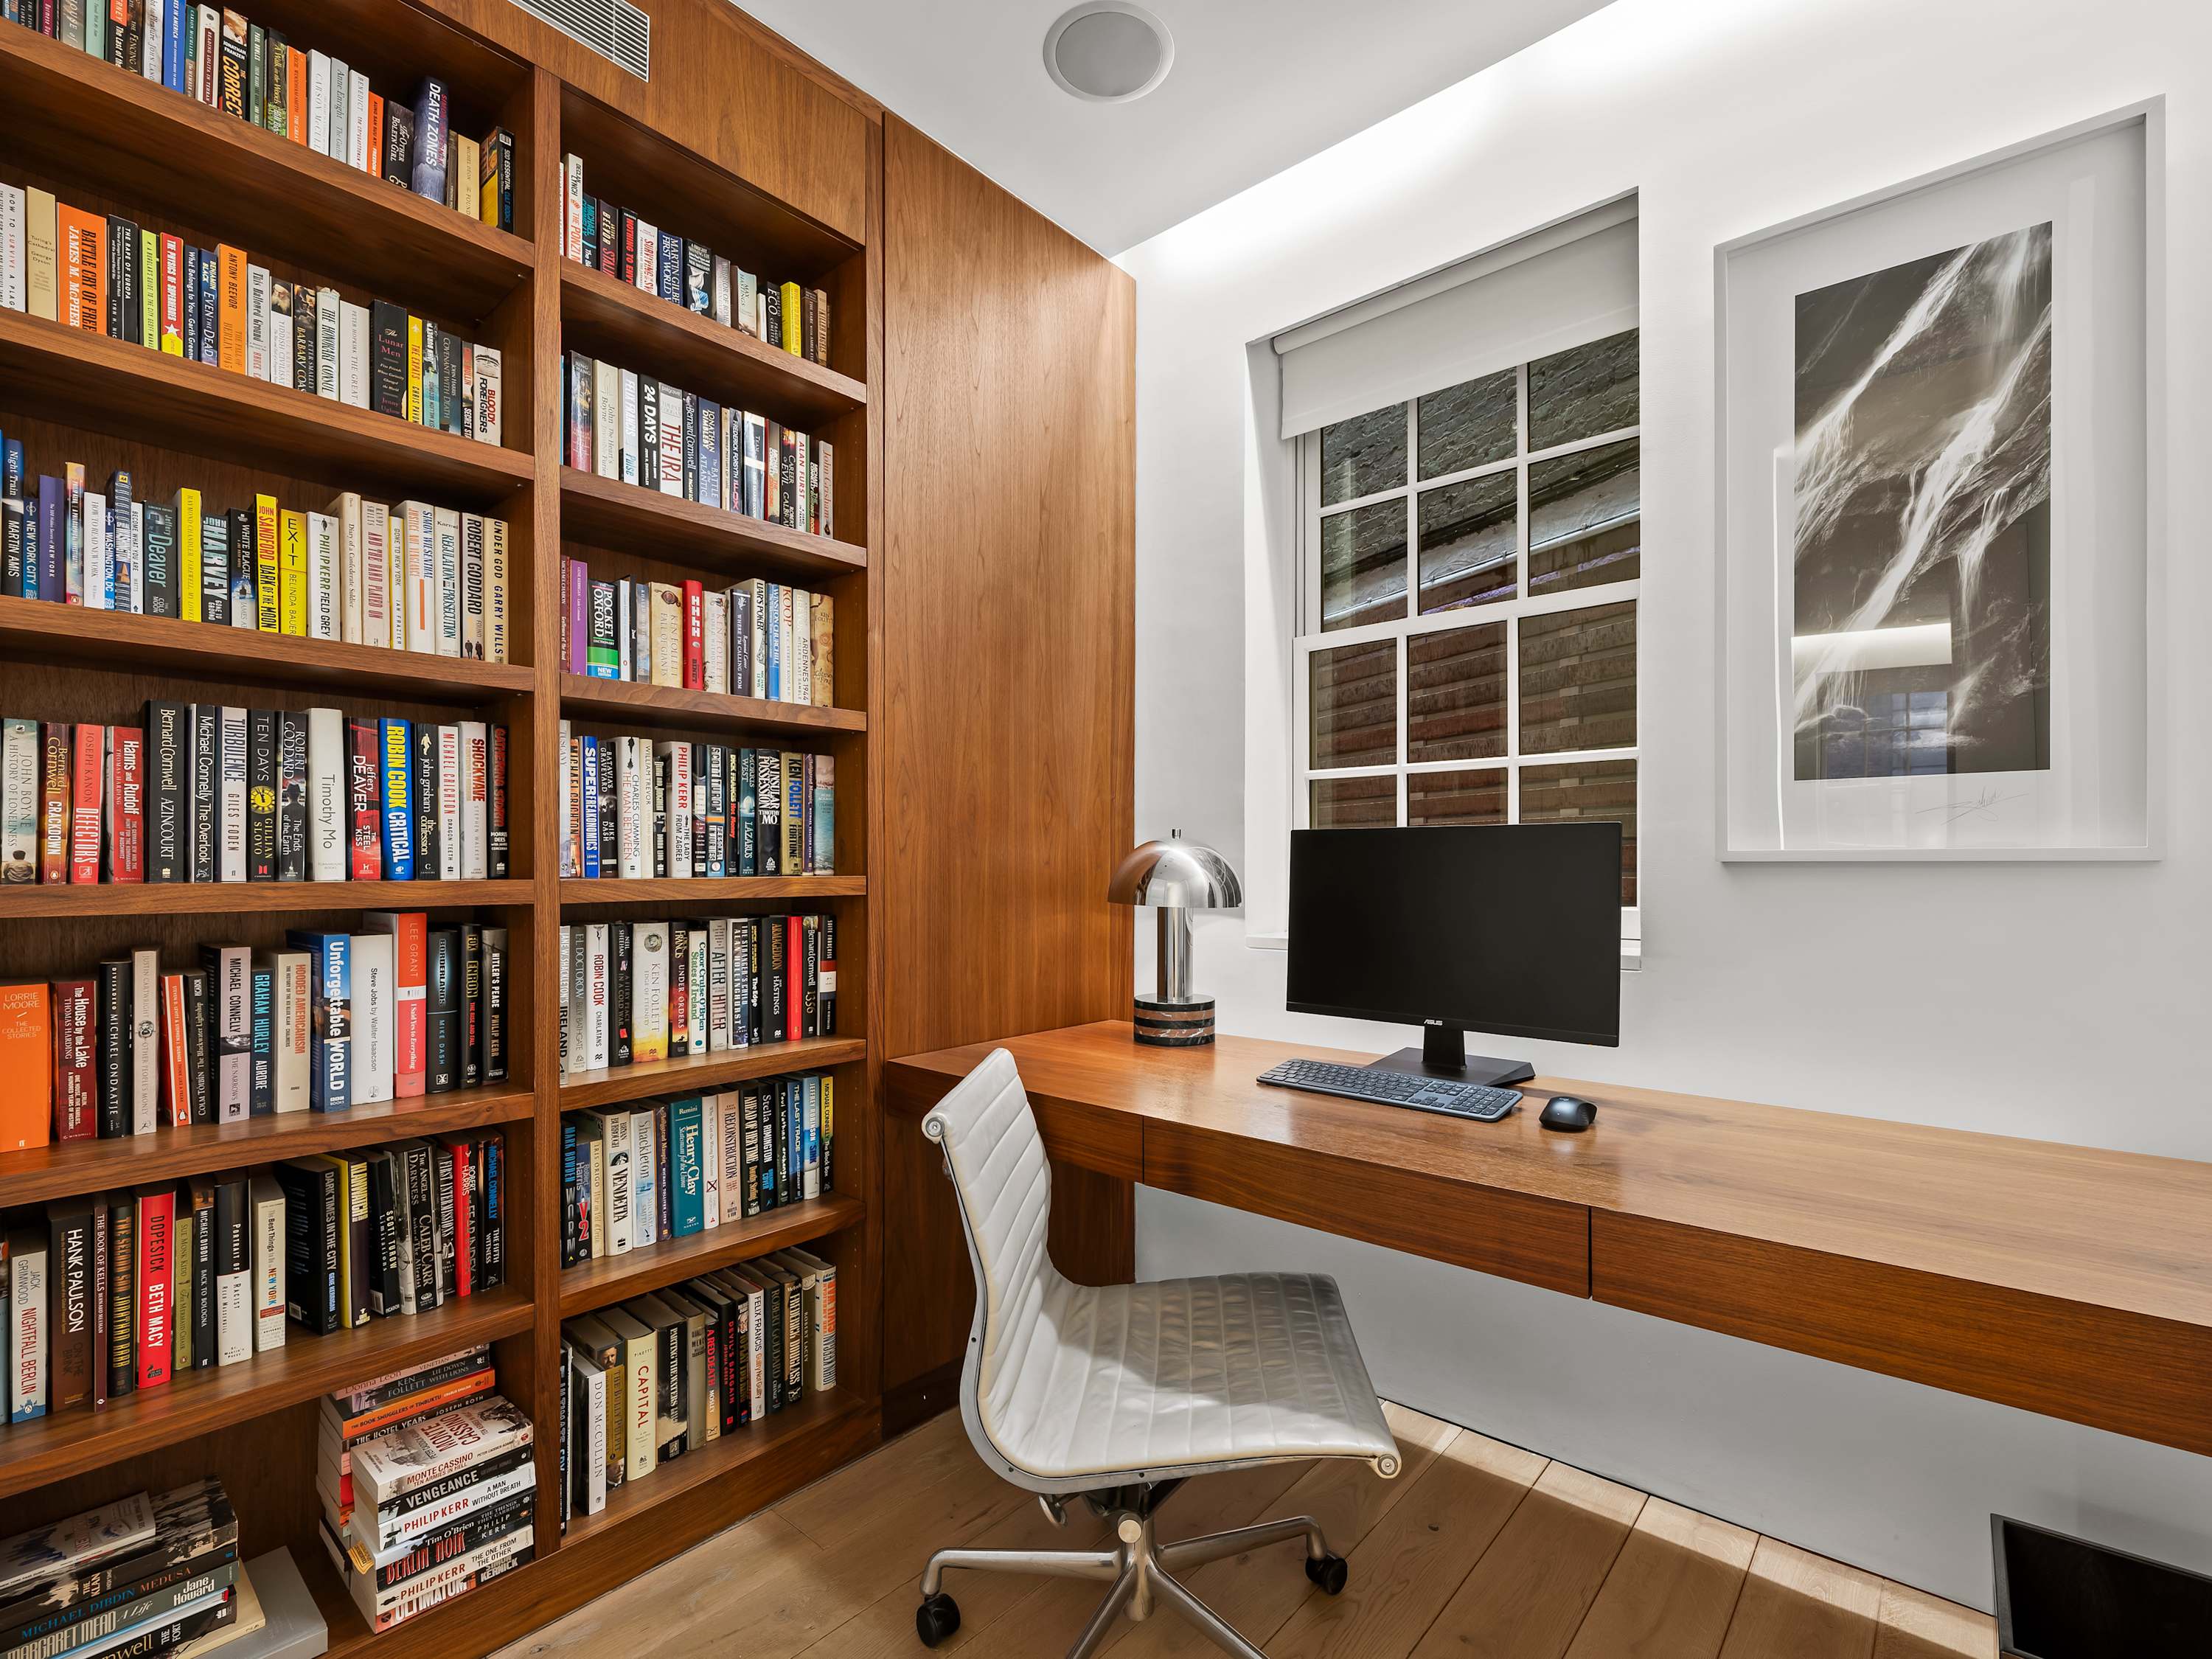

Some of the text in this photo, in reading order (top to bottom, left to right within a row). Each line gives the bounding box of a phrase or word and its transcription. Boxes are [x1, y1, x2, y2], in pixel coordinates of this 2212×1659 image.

[335, 69, 345, 119] Anne Enright
[426, 83, 440, 166] DEATH ZONES
[602, 212, 611, 245] BEEVOR
[125, 262, 131, 271] OF
[229, 253, 237, 309] ANTONY BEEVOR
[204, 291, 215, 316] EVEN
[768, 288, 776, 315] ECO
[204, 330, 215, 356] DEAD
[479, 377, 488, 434] FOREIGNERS
[487, 389, 495, 424] BLOODY
[644, 384, 656, 444] 24 DAYS
[9, 451, 18, 495] Night Train
[661, 422, 681, 482] THE IRA
[7, 520, 19, 577] MARTIN AMIS
[27, 521, 35, 585] NEW YORK CITY
[147, 534, 172, 588] Deaver
[203, 524, 227, 601] HARVEY
[259, 516, 274, 560] SANDFORD
[260, 564, 275, 585] DARK
[320, 535, 330, 636] PHILIP KERR FIELD GREY
[467, 518, 481, 614] ROBERT GODDARD
[261, 606, 276, 628] MOON
[262, 595, 274, 604] THE
[594, 589, 604, 637] OXFORD
[603, 591, 612, 636] POCKET
[756, 582, 765, 631] LIAR'S POKER
[784, 588, 792, 626] KOOP
[225, 720, 245, 782] TURBULENCE
[257, 717, 269, 782] TEN DAYS
[443, 734, 453, 769] MICHAEL
[472, 738, 484, 801] SHOCKWAVE
[160, 709, 176, 860] Bernard Cornwell AZINCOURT
[195, 716, 212, 863] Michael Connelly The Overlook
[352, 755, 366, 812] DEAVER
[387, 726, 410, 863] ROBIN COOK CRITICAL
[443, 773, 456, 814] CRICHTON
[585, 747, 597, 850] SUPERFREAKONOMICS
[678, 747, 687, 809] PHILIP KERR
[788, 759, 801, 818] KEN FOLLETT
[74, 808, 99, 863] DEFECTORS
[319, 774, 336, 849] Timothy Mo
[623, 771, 631, 860] THE MAN BETWEEN
[632, 775, 641, 857] CHARLES CUMMING
[744, 821, 753, 858] LAZARUS
[74, 987, 84, 998] The
[594, 954, 604, 979] ROBIN
[594, 981, 605, 1006] COOK
[712, 952, 726, 1030] AFTER HITLER
[805, 930, 816, 1013] Bernard Cornwell 1356
[75, 998, 88, 1026] House
[229, 958, 242, 1032] MICHAEL CONNELLY
[327, 942, 344, 1090] Unforgettable WORLD
[369, 989, 378, 1006] Jobs
[369, 1007, 378, 1015] by
[678, 996, 686, 1028] ORDERS
[75, 1036, 84, 1045] the
[75, 1046, 89, 1068] Lake
[254, 975, 269, 1089] GRAHAM HURLEY AURORE
[564, 1127, 575, 1182] MARK BOWDEN
[639, 1121, 650, 1178] Shackleton
[725, 1112, 737, 1179] RECONSTRUCTION
[763, 1095, 772, 1163] Stella RIMINGTON
[684, 1123, 699, 1195] Henry Clay
[613, 1169, 628, 1223] VENDETTA
[419, 1215, 434, 1287] CALEB CARR
[68, 1229, 83, 1332] HANK PAULSON
[148, 1215, 165, 1348] DOPESICK BETH MACY
[21, 1308, 36, 1395] NIGHTFALL BERLIN
[594, 1382, 602, 1409] DON
[637, 1366, 649, 1428] CAPITAL
[406, 1453, 473, 1485] MONTE CASSINO
[406, 1470, 480, 1509] VENGEANCE
[403, 1498, 469, 1533] PHILIP KERR
[141, 1568, 192, 1592] MEDUSA
[173, 1583, 215, 1606] Howard
[183, 1576, 209, 1594] Jane
